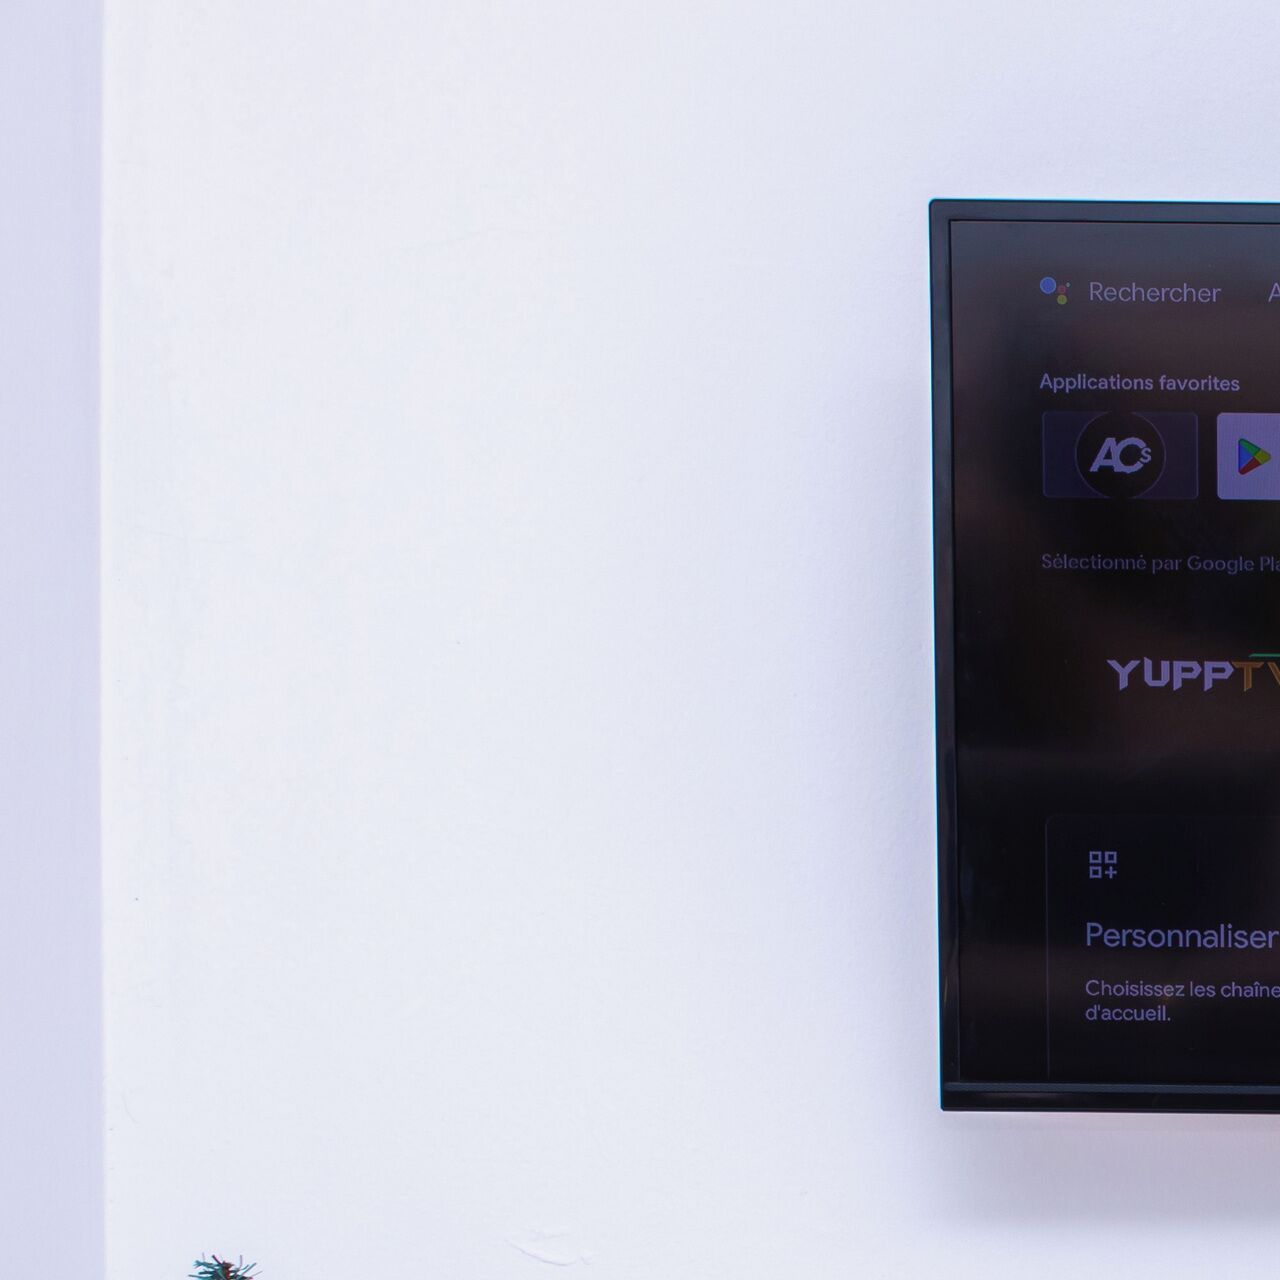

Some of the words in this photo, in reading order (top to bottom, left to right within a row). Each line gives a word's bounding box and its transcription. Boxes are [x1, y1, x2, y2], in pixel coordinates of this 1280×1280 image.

[1089, 282, 1222, 303] Rechercher
[1040, 373, 1154, 393] Applications
[1159, 374, 1240, 391] favorites
[1041, 553, 1147, 570] Sélectionné
[1152, 557, 1182, 574] par
[1187, 555, 1255, 575] Google
[1085, 923, 1280, 949] Personnaliser
[1085, 980, 1185, 998] Choisissez
[1190, 981, 1216, 998] les
[1085, 1004, 1172, 1022] d'accueil.
